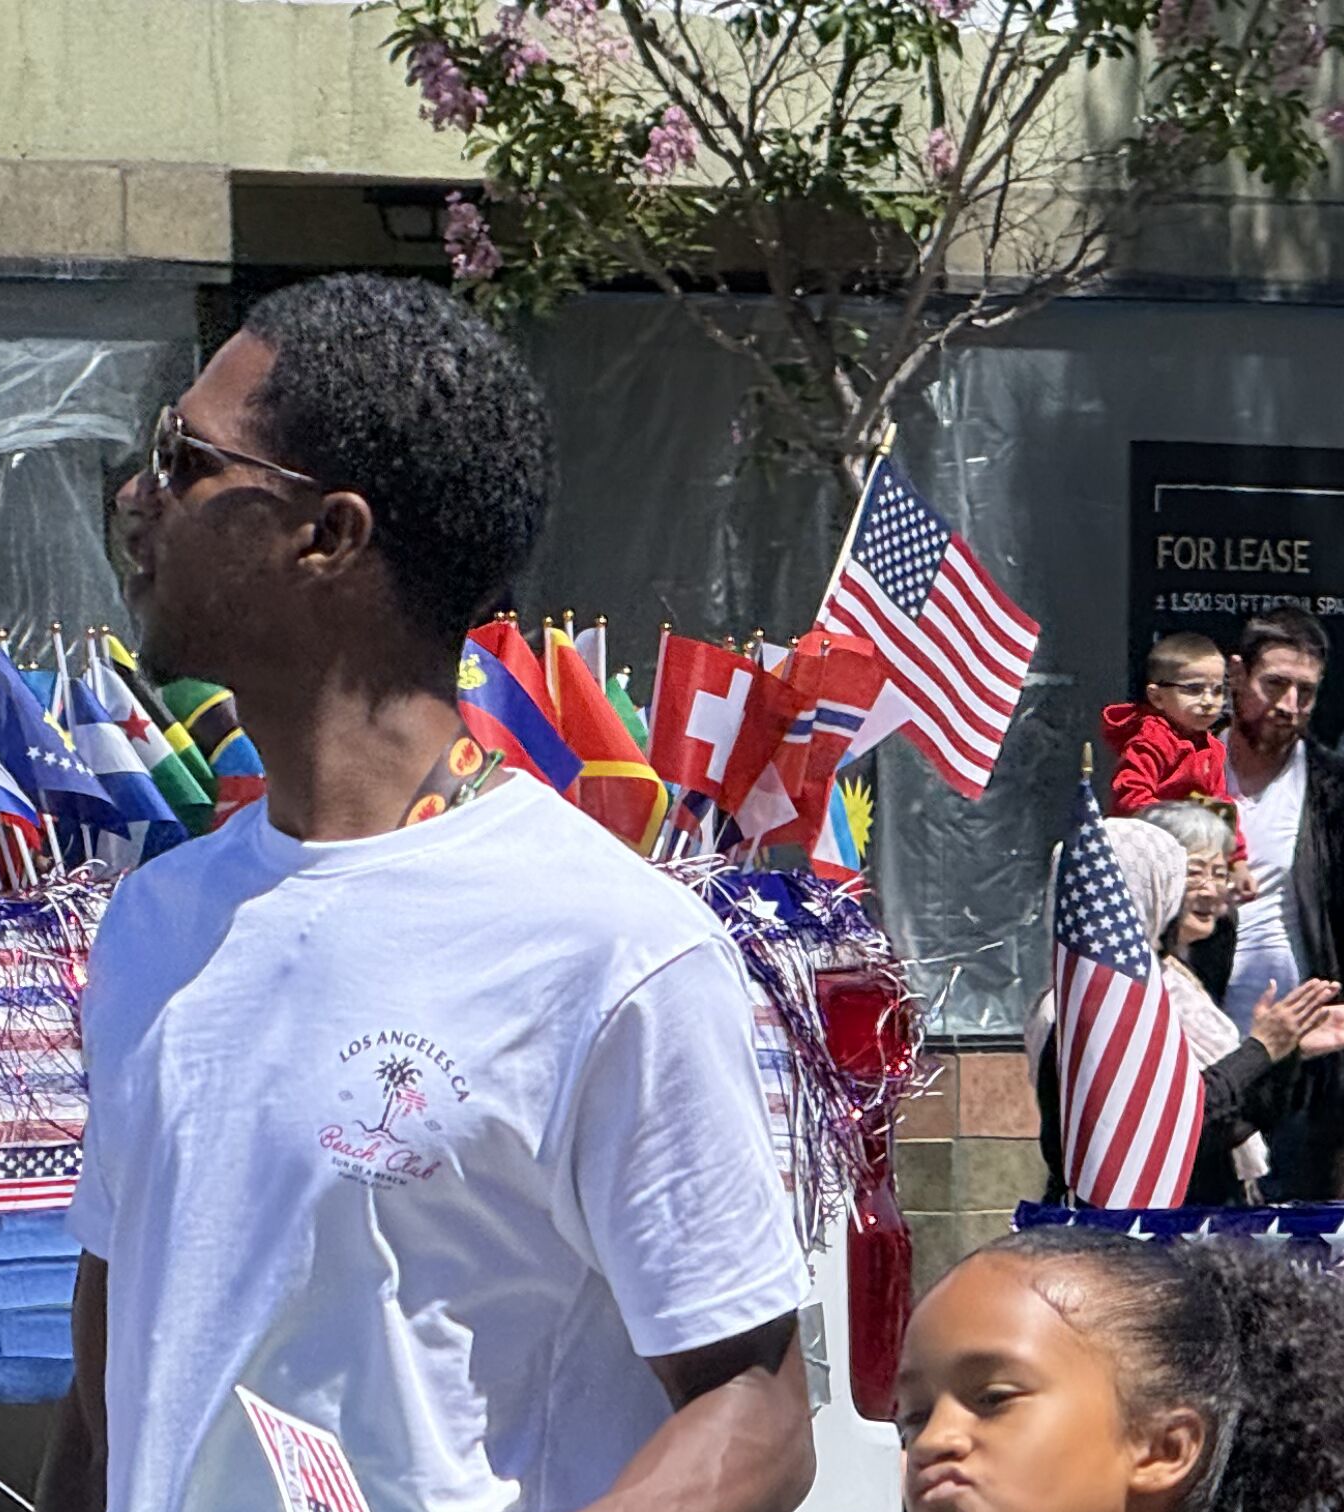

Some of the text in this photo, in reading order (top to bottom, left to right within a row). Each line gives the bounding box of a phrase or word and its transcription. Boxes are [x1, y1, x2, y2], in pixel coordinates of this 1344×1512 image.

[1156, 536, 1313, 574] FOR LEASE
[339, 1033, 372, 1064] LOS
[450, 1074, 471, 1103] CA
[317, 1124, 382, 1163] Beach
[385, 1149, 442, 1181] Club
